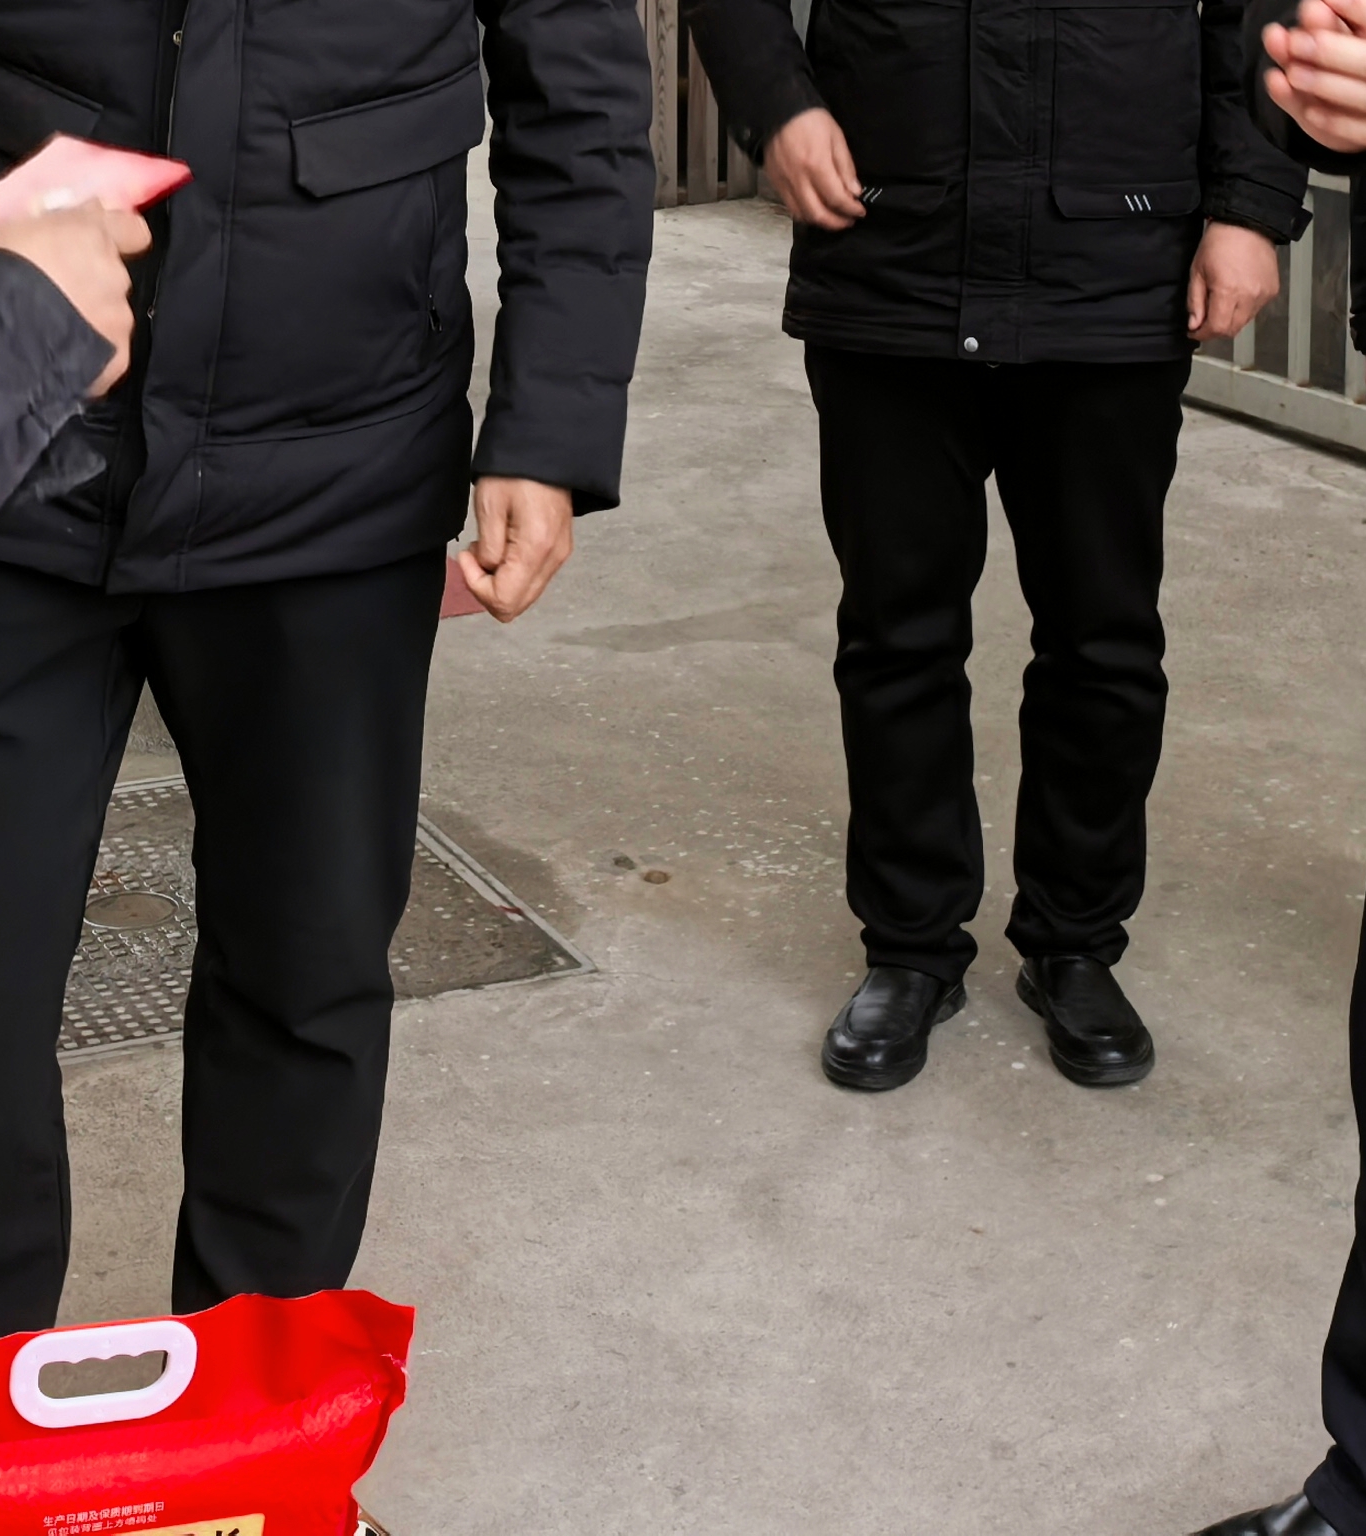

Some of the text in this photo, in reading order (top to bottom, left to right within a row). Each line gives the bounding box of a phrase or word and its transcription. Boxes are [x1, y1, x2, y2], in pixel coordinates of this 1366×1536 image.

[43, 1501, 165, 1527] 生产日期及保质期到期日
